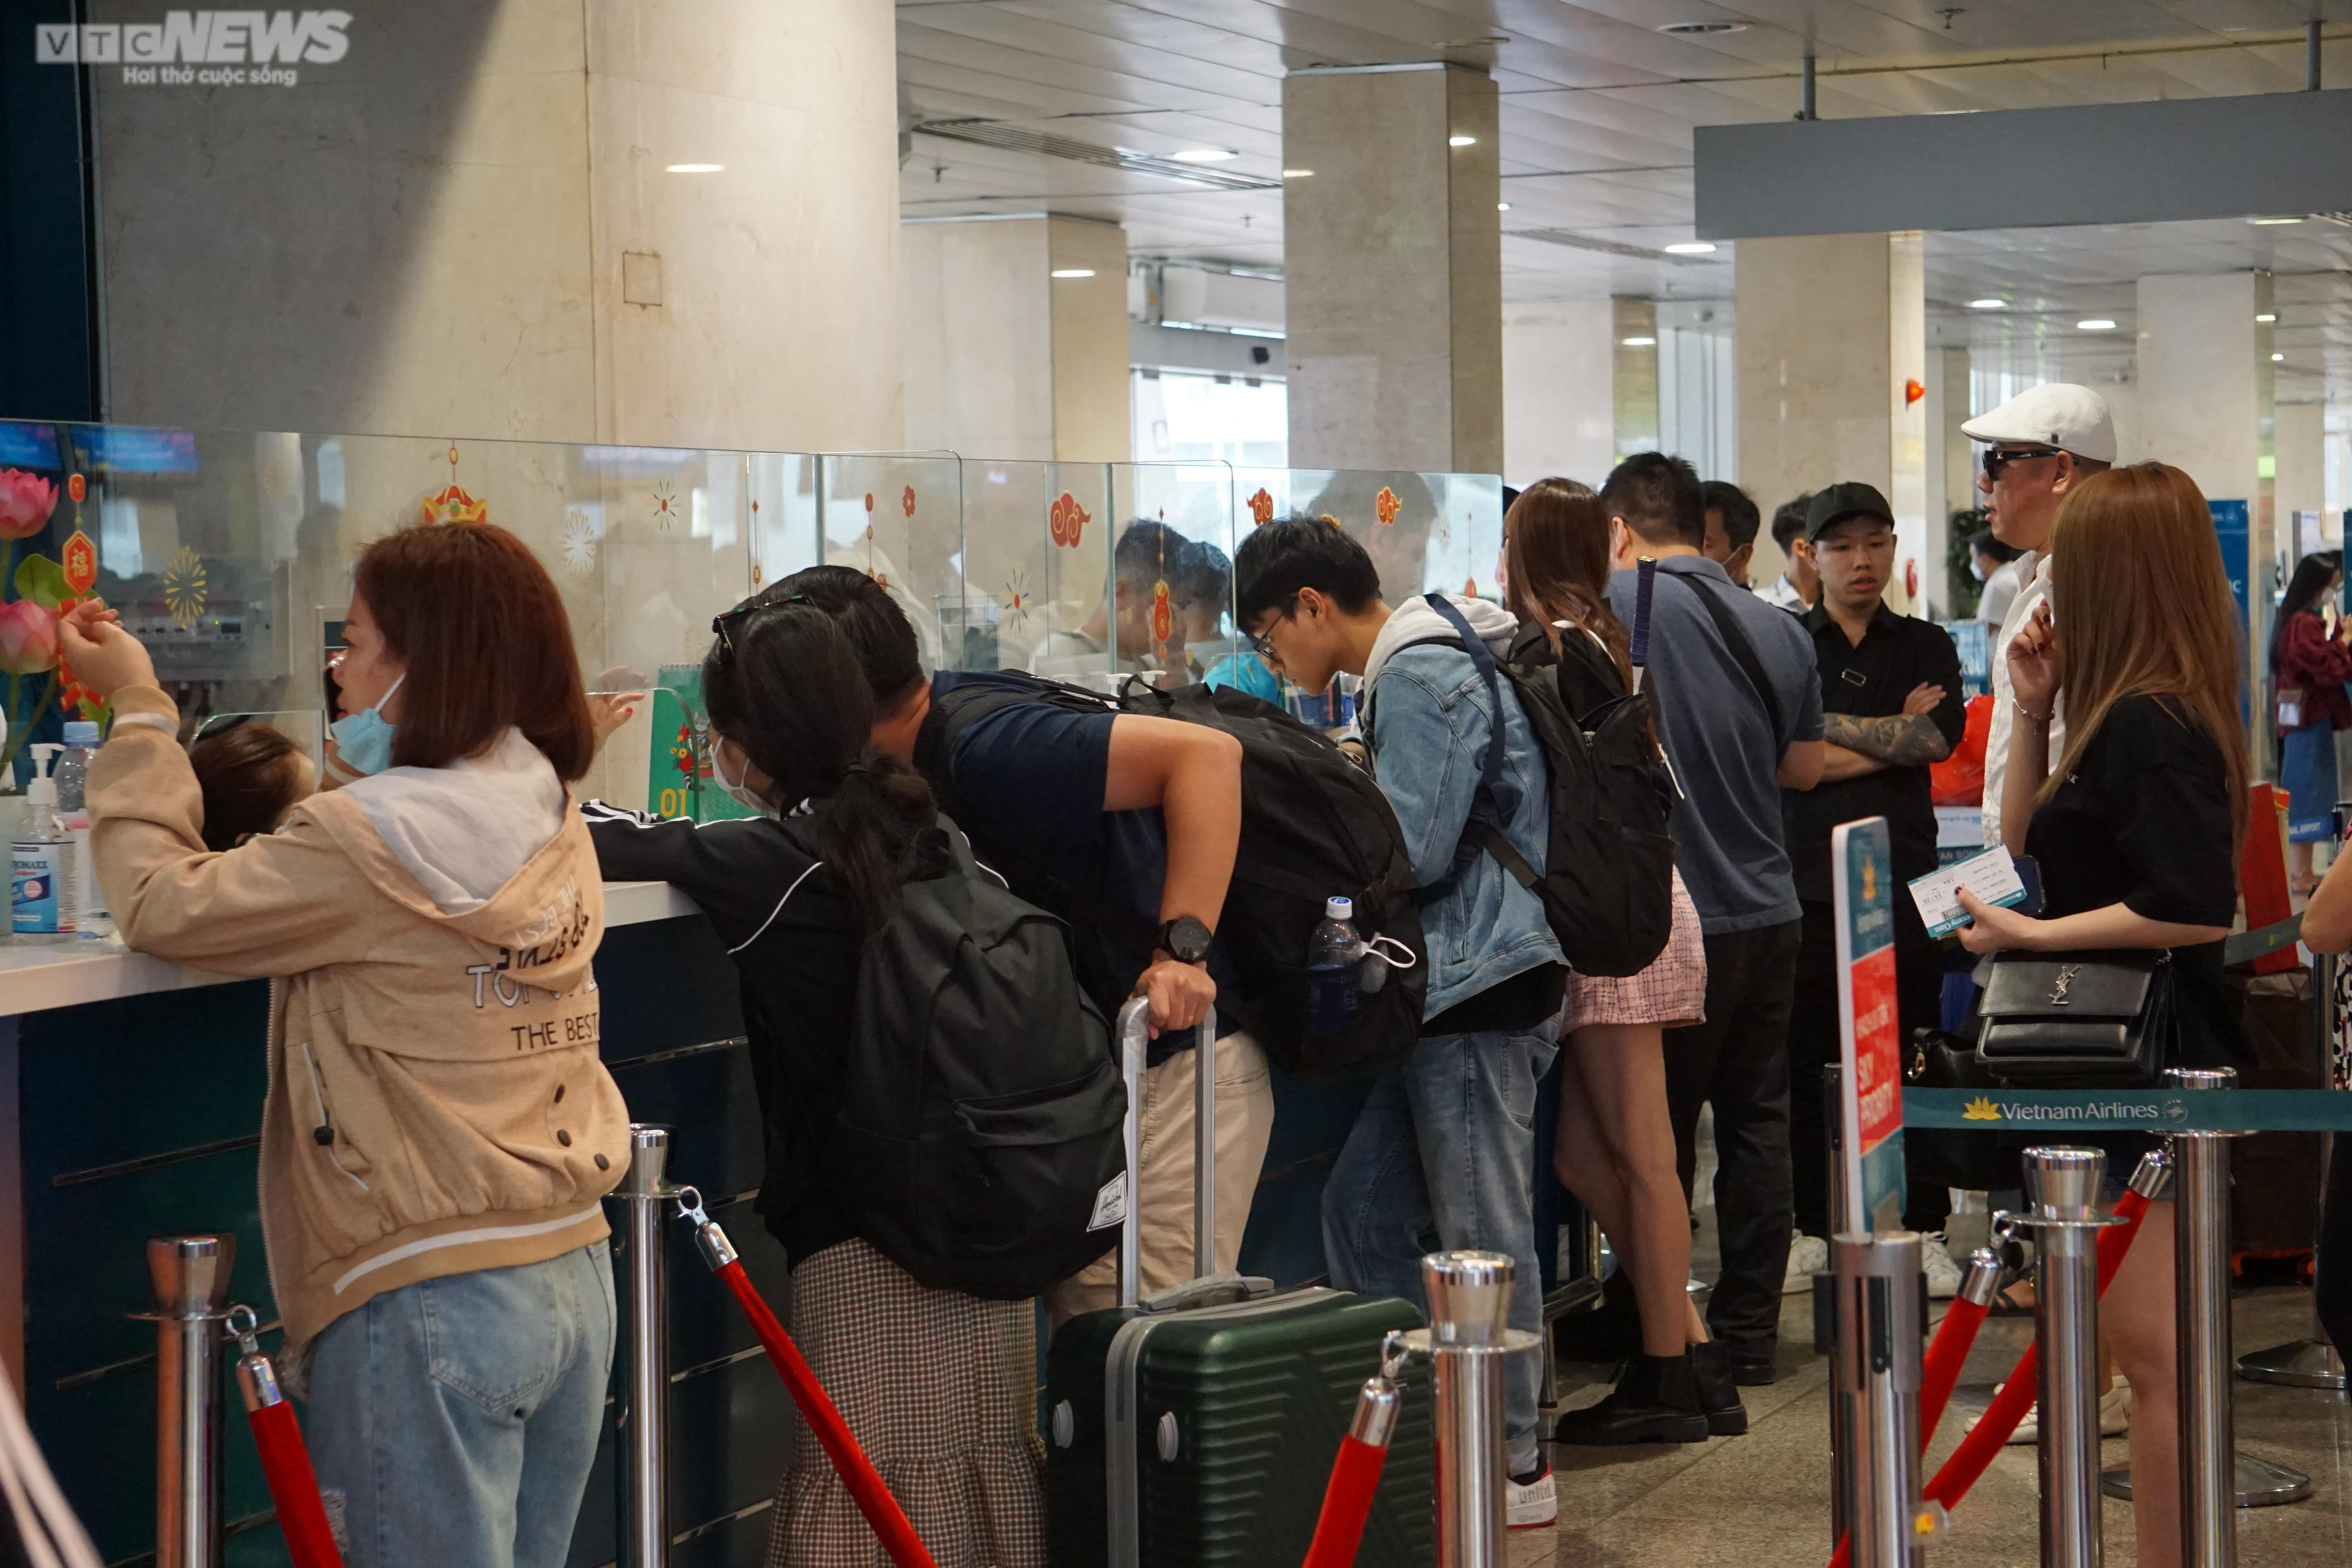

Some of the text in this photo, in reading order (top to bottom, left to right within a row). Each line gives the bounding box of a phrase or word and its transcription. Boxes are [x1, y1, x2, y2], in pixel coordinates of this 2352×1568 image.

[660, 788, 686, 817] 01
[511, 1012, 598, 1051] THE BEST
[2002, 1098, 2159, 1120] Vietnam Airlines
